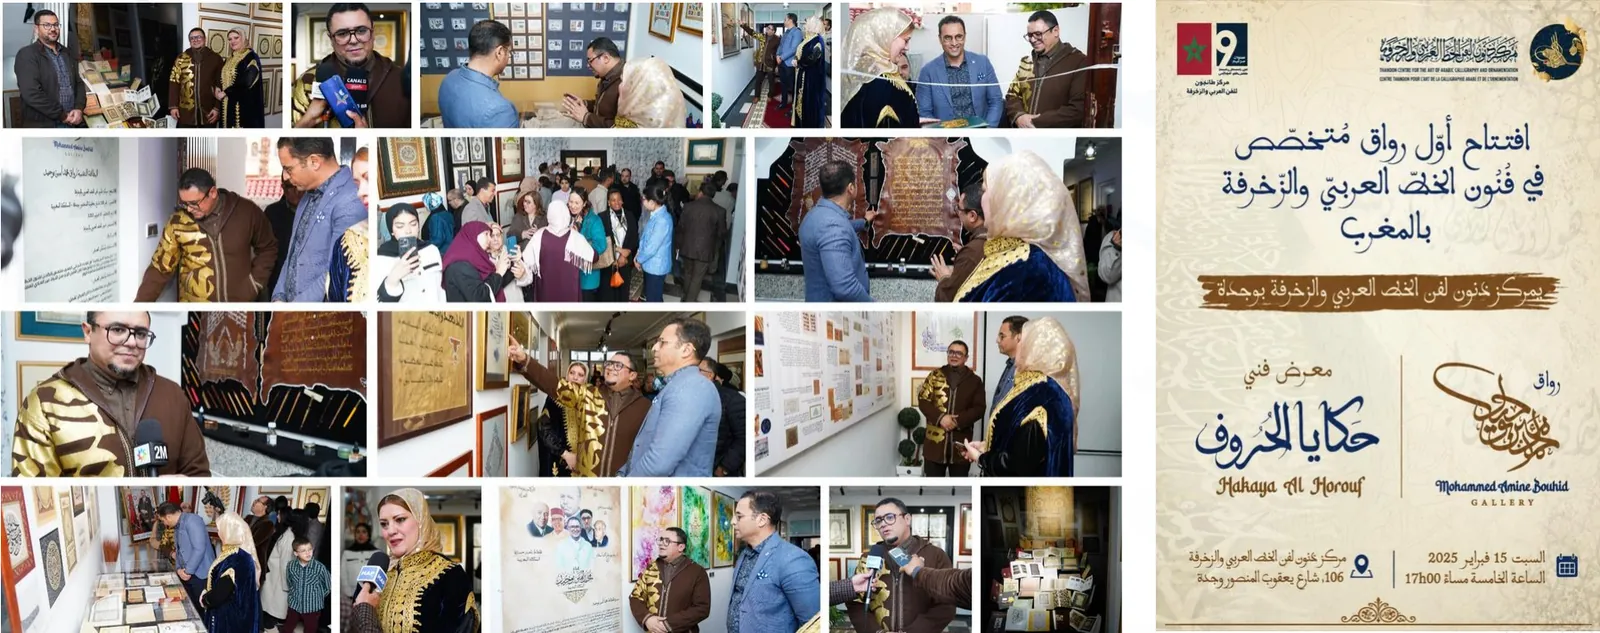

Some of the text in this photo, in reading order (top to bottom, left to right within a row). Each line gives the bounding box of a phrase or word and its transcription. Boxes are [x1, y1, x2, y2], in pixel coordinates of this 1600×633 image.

[1360, 122, 1407, 165] رواق
[1462, 122, 1530, 170] افتتاح
[1523, 164, 1544, 202] في
[1340, 210, 1431, 253] بالمغرب
[1217, 279, 1265, 308] بوجدة
[1270, 277, 1328, 308] والزخرفة
[1332, 277, 1376, 309] العربي
[1380, 277, 1419, 298] الخط
[1424, 277, 1448, 303] لفن
[1243, 359, 1333, 390] معرض فني
[1533, 370, 1560, 397] رواق
[154, 445, 168, 460] 2M
[1216, 475, 1366, 498] Hakaya Al Horouf
[1435, 477, 1570, 496] Mohammed Amine Bouhid
[1471, 499, 1535, 507] GALLERY
[1189, 549, 1224, 569] والزخرفة
[1225, 549, 1253, 570] العربي
[1253, 549, 1278, 562] الخط
[1278, 549, 1294, 566] لفن
[1318, 549, 1347, 568] مركز
[1428, 550, 1546, 570] السبت 15 فبراير 2025
[1197, 572, 1224, 589] وجدة
[1223, 570, 1260, 589] المنصور
[1262, 572, 1294, 589] يعقوب
[1296, 570, 1320, 590] شارع
[1405, 572, 1441, 584] 17h00
[1471, 570, 1508, 584] الخامسة
[1511, 570, 1546, 584] الساعة
